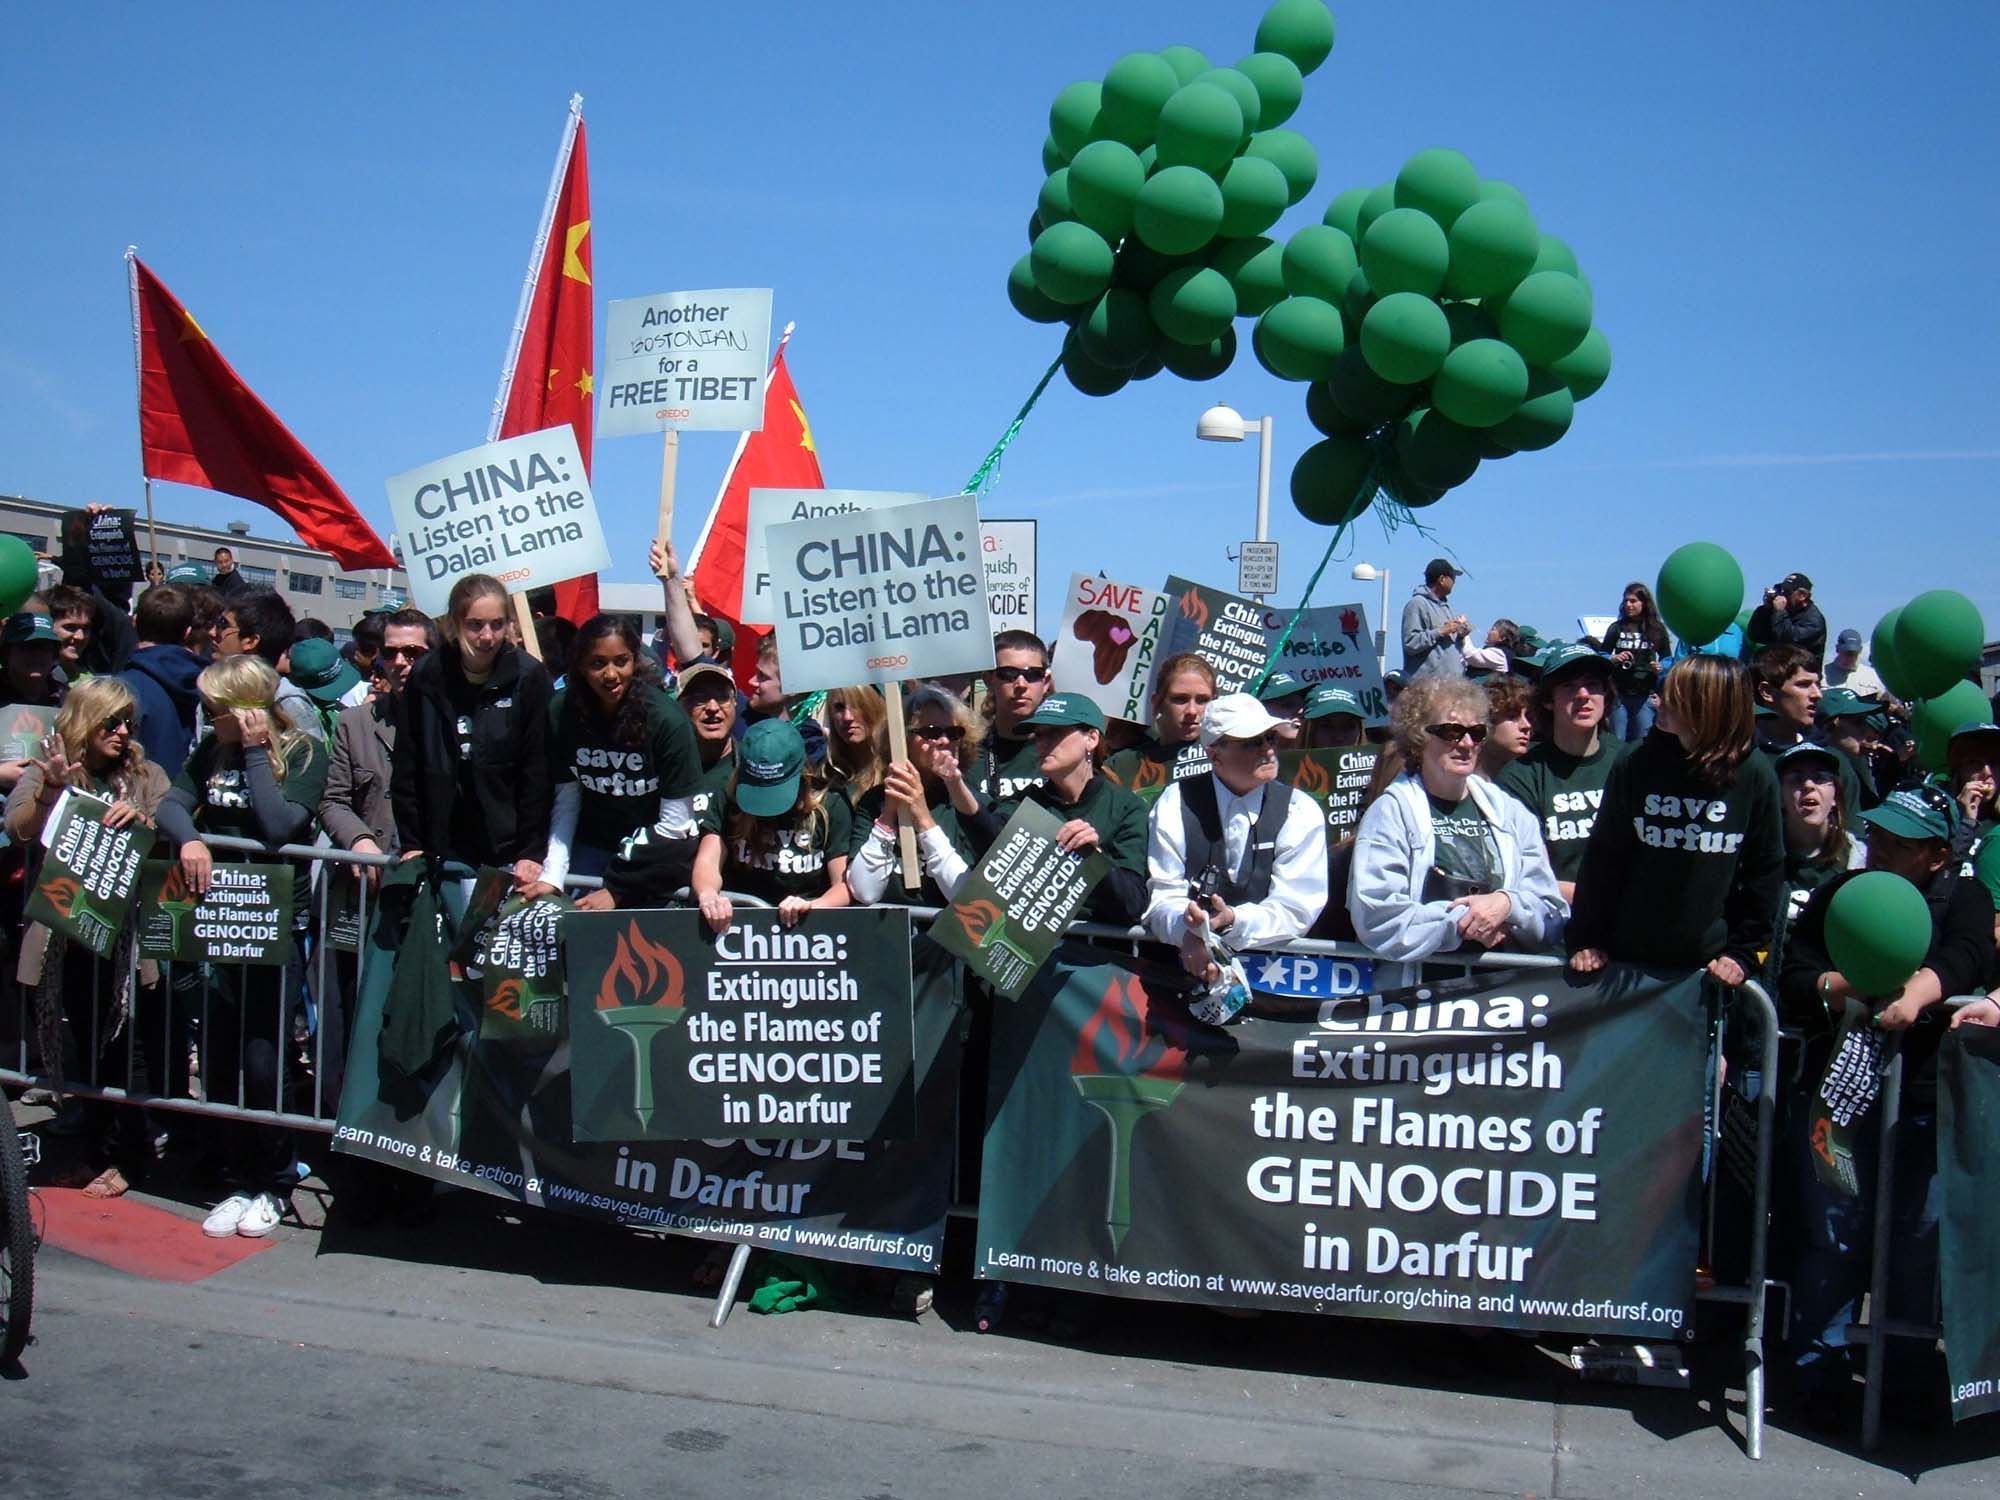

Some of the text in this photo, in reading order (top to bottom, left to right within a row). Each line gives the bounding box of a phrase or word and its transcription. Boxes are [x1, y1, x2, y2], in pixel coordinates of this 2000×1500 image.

[642, 303, 729, 328] Another
[630, 329, 748, 354] BOSTONIAN
[658, 357, 698, 374] for a
[610, 377, 757, 408] FREE TIBET
[656, 409, 690, 419] CREDO
[415, 453, 570, 520] CHINA:
[408, 490, 585, 556] Listen to the
[425, 521, 583, 581] Dalai Lama
[796, 524, 966, 583] CHINA:
[784, 570, 977, 619] Listen to the
[986, 576, 1031, 593] lames of
[1077, 578, 1143, 614] SAVE
[799, 613, 875, 651] Dalai
[882, 608, 970, 641] Lama
[866, 655, 908, 669] CREDO
[1123, 596, 1167, 721] DARFUR
[1199, 633, 1267, 665] the Flames
[1216, 674, 1246, 694] Darf
[1301, 665, 1362, 682] GENOCIDE
[576, 747, 643, 772] save
[1328, 792, 1348, 808] the
[1644, 794, 1727, 823] save
[55, 814, 85, 864] China:
[70, 820, 101, 876] Extinguish
[92, 834, 112, 873] Flames
[983, 827, 1030, 883] China:
[83, 871, 102, 892] the
[98, 829, 133, 901] GENOCIDE
[115, 849, 141, 898] in Darfur
[210, 869, 267, 887] China:
[996, 836, 1049, 900] Extinguish
[205, 890, 270, 907] Extinguish
[1008, 897, 1029, 920] the
[1023, 857, 1060, 900] Flames
[1022, 850, 1084, 932] GENOCIDE
[1044, 876, 1089, 933] in Darfur
[194, 924, 279, 940] GENOCIDE
[195, 907, 280, 923] the Flames of
[208, 943, 265, 958] in Darfur
[716, 924, 847, 960] China:
[523, 955, 536, 978] the
[708, 971, 858, 1009] Extinguish
[687, 1011, 882, 1042] the Flames of
[1317, 989, 1550, 1031] China:
[688, 1053, 882, 1084] GENOCIDE
[1293, 1039, 1562, 1096] Extinguish
[1826, 1032, 1863, 1108] Extinguish
[723, 1094, 851, 1124] in Darfur
[1250, 1092, 1602, 1154] the Flames of
[1831, 1098, 1849, 1122] the
[377, 1135, 416, 1158] more
[419, 1145, 432, 1163] &
[435, 1149, 472, 1174] take
[474, 1162, 523, 1188] action
[526, 1176, 544, 1193] at
[549, 1184, 753, 1237] www.savedarfur.org/china
[759, 1222, 790, 1242] and
[795, 1230, 934, 1262] www.darfursf.org
[615, 1146, 657, 1193] in
[670, 1157, 811, 1215] Darfur
[1247, 1156, 1597, 1221] GENOCIDE
[1303, 1223, 1534, 1282] in Darfur
[988, 1247, 1683, 1328] Learn more & take action at www.savedarfur.org/china and www.darfursf.org
[1951, 1379, 1992, 1403] Learn
